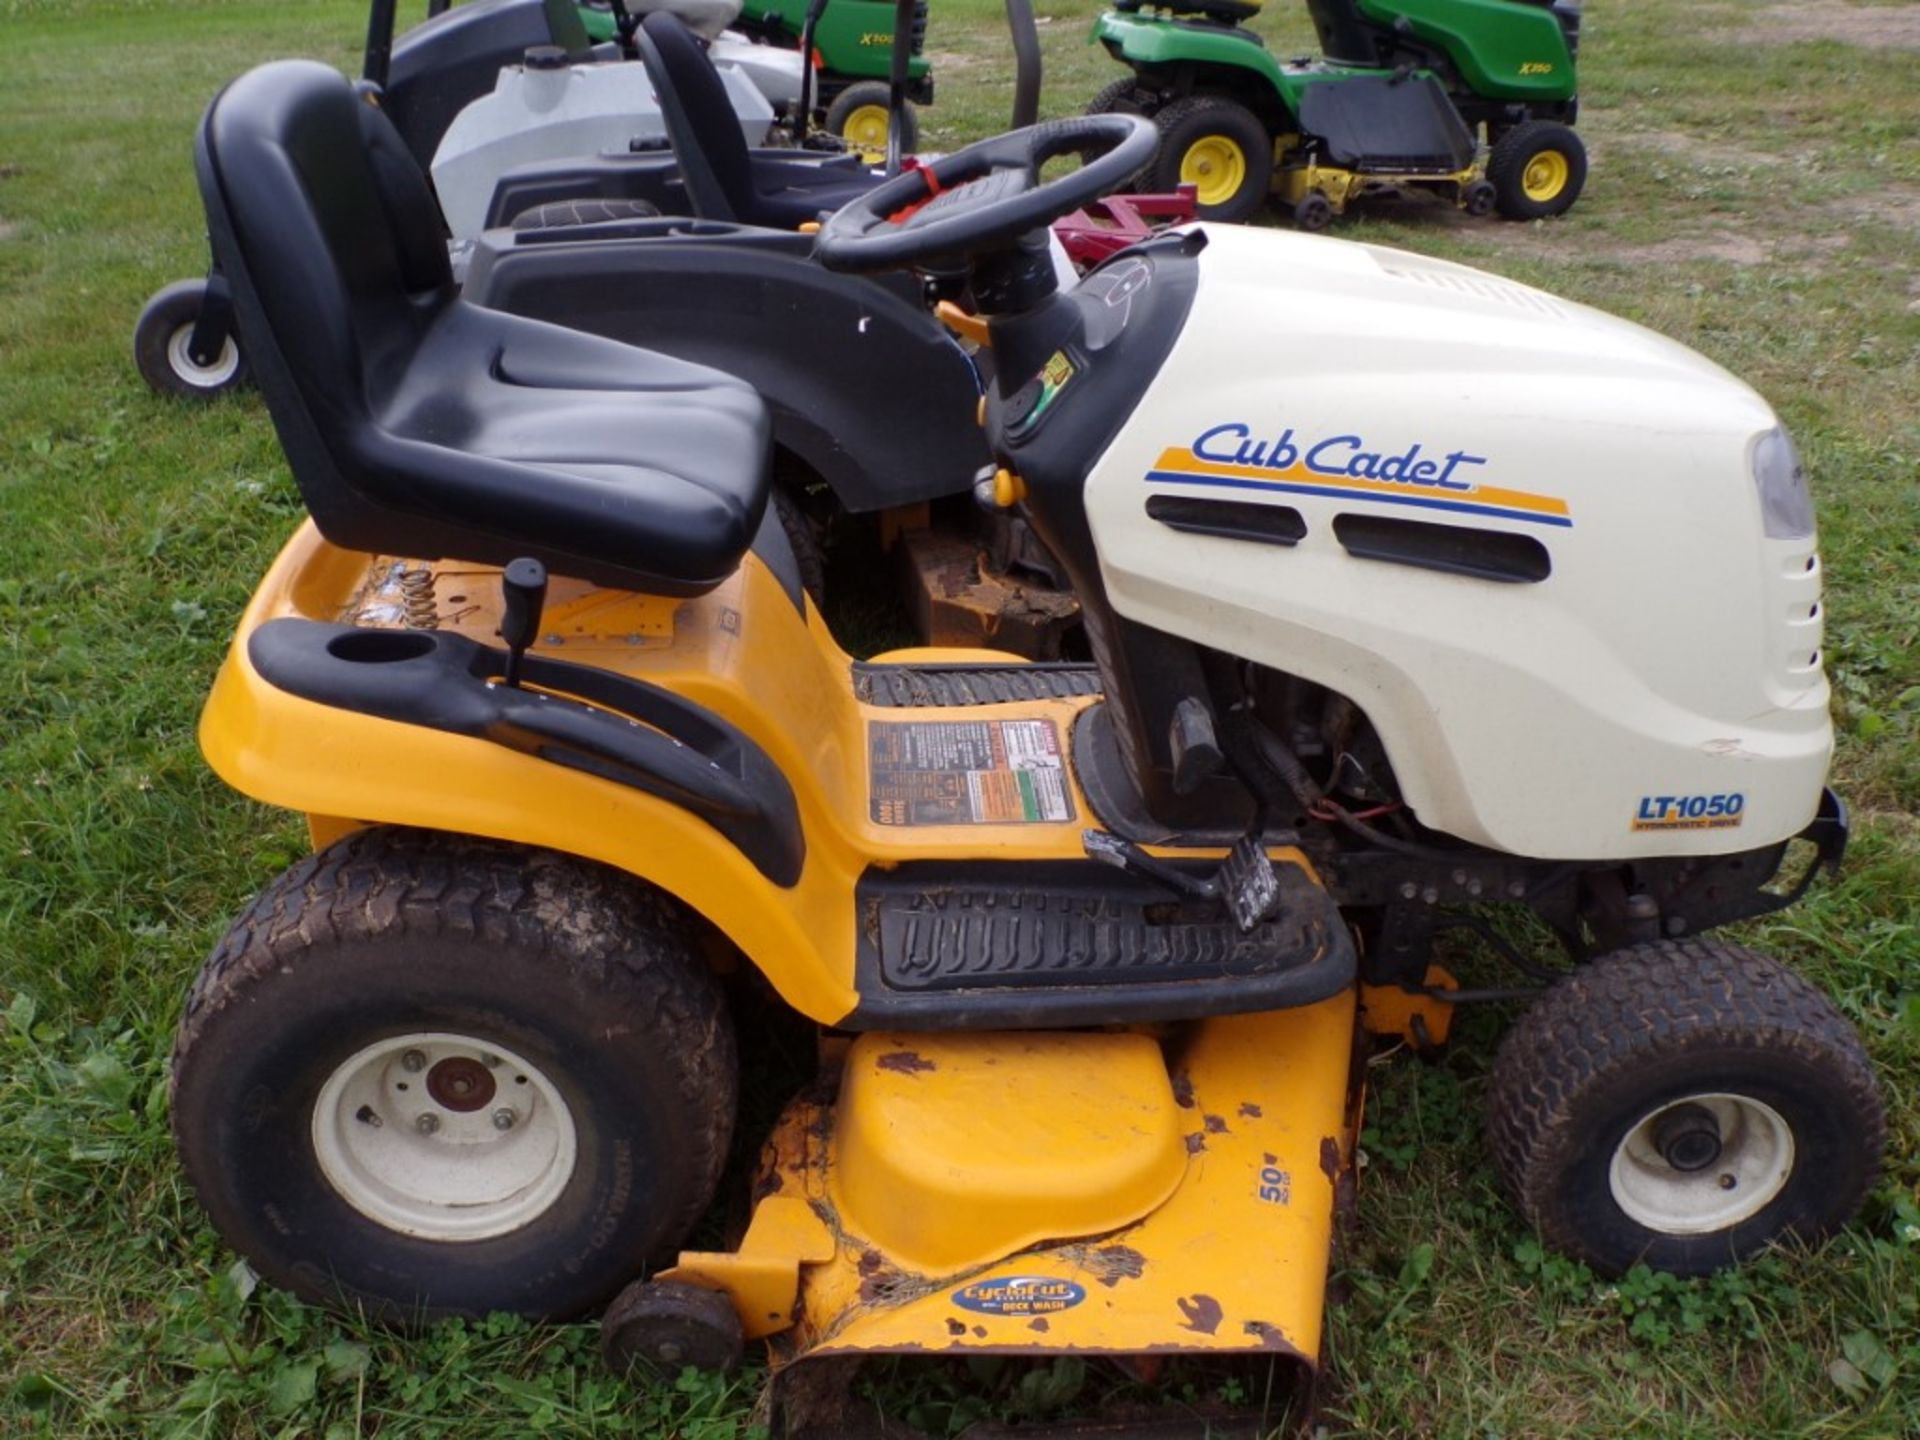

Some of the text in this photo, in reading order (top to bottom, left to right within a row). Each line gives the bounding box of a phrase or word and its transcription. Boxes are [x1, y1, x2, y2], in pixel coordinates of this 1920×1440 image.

[1191, 422, 1488, 491] Cub Cadet
[1638, 793, 1745, 819] LT1050
[1260, 1168, 1282, 1203] 50
[1002, 1302, 1030, 1313] DECK
[1031, 1300, 1067, 1311] WASH
